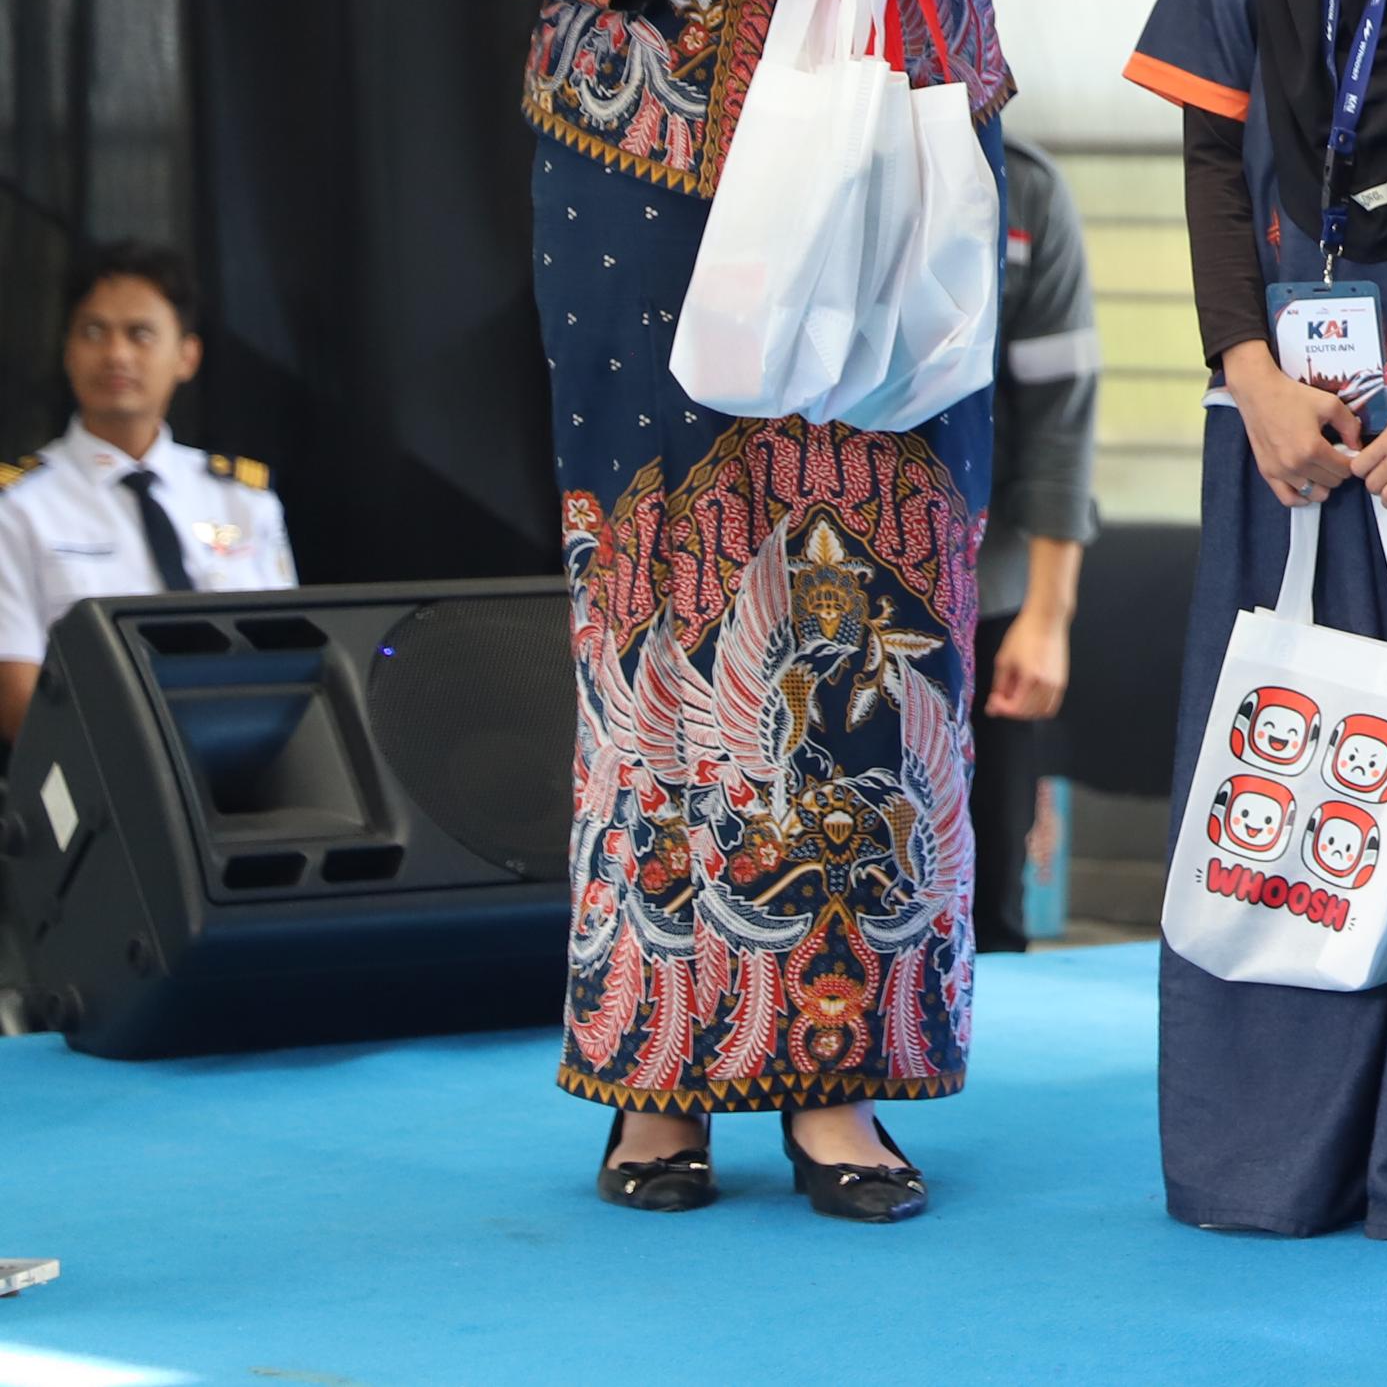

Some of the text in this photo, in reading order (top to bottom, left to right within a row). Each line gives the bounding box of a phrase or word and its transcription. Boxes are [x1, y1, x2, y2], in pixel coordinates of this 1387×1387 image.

[1308, 320, 1348, 339] KAI
[1305, 343, 1355, 354] EDUTRAIN
[1206, 857, 1350, 931] WHOOSH
